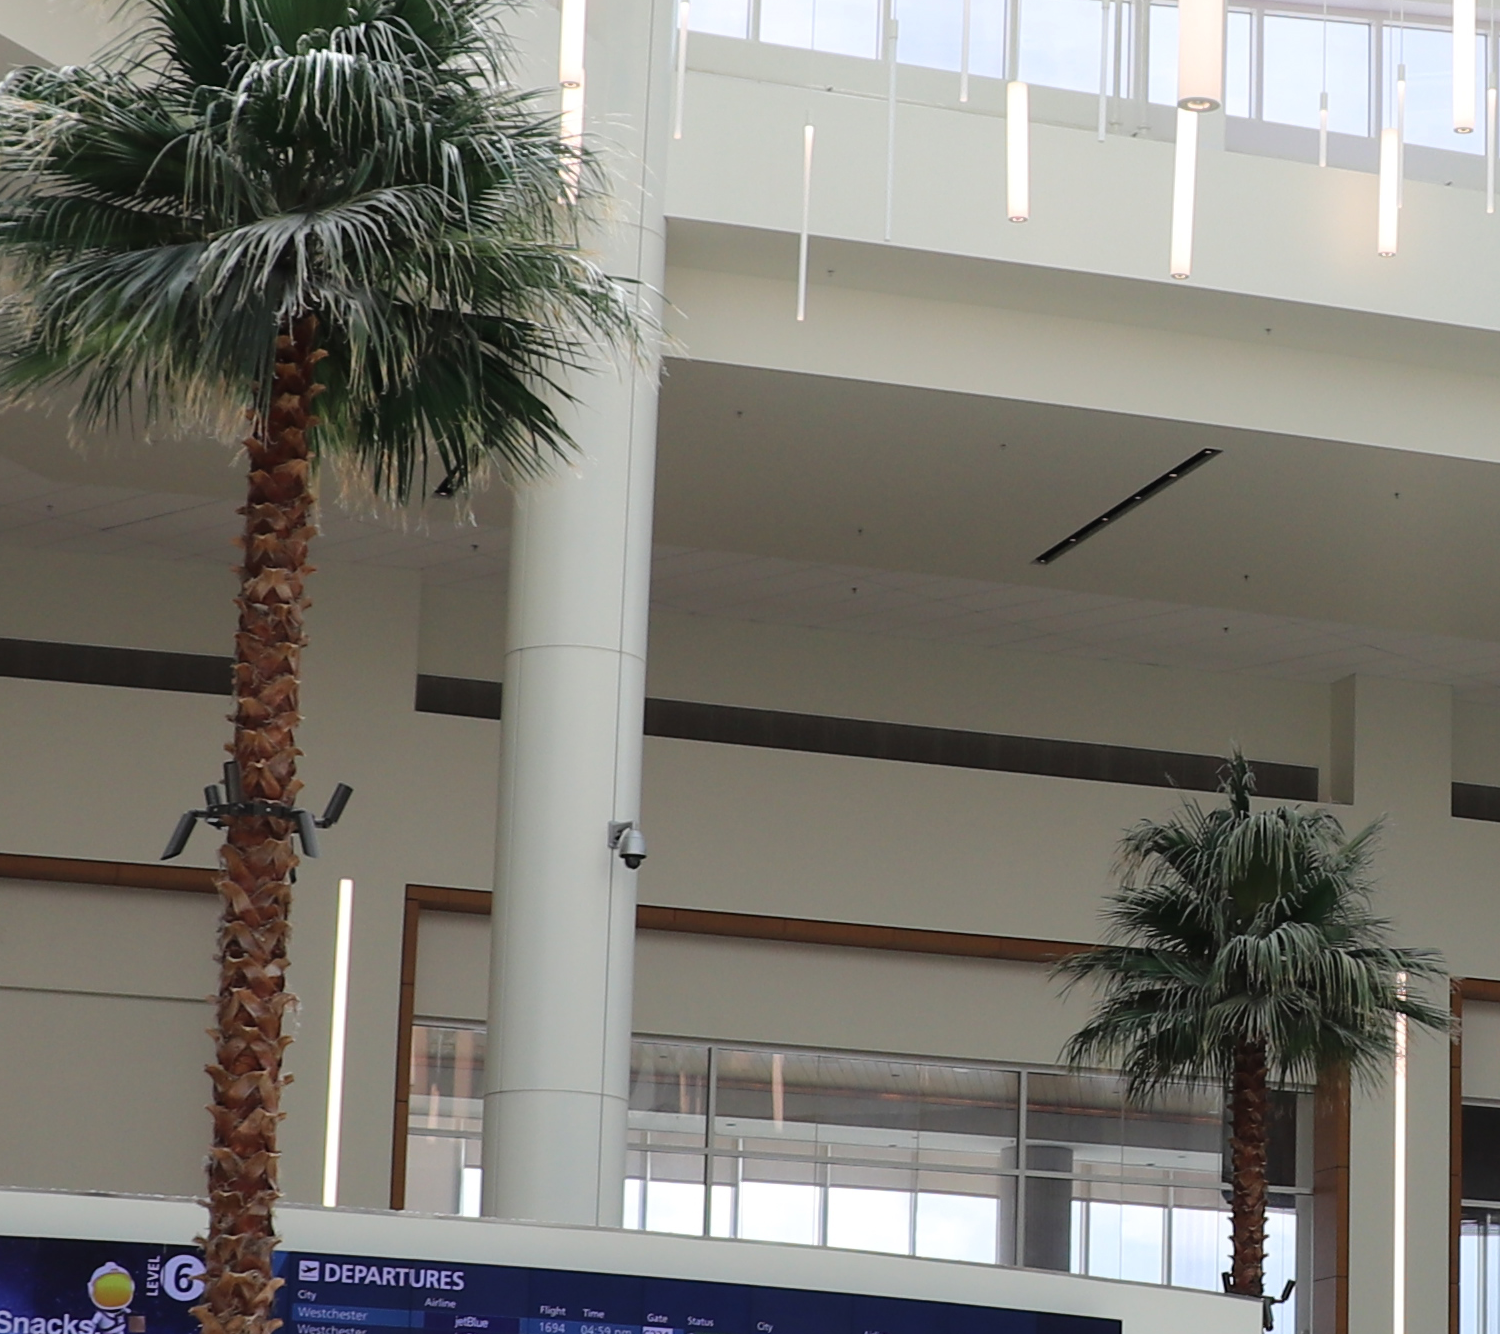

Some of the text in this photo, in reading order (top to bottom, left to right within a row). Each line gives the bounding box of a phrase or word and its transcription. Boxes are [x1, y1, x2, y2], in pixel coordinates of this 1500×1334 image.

[145, 1255, 194, 1297] LEVEL 6
[324, 1263, 466, 1291] DEPARTURES
[297, 1289, 715, 1328] City Airline Flight Time Gate Status
[298, 1307, 369, 1322] Westchester
[454, 1314, 490, 1330] jetBlue
[539, 1322, 566, 1334] 1694
[756, 1321, 773, 1334] City
